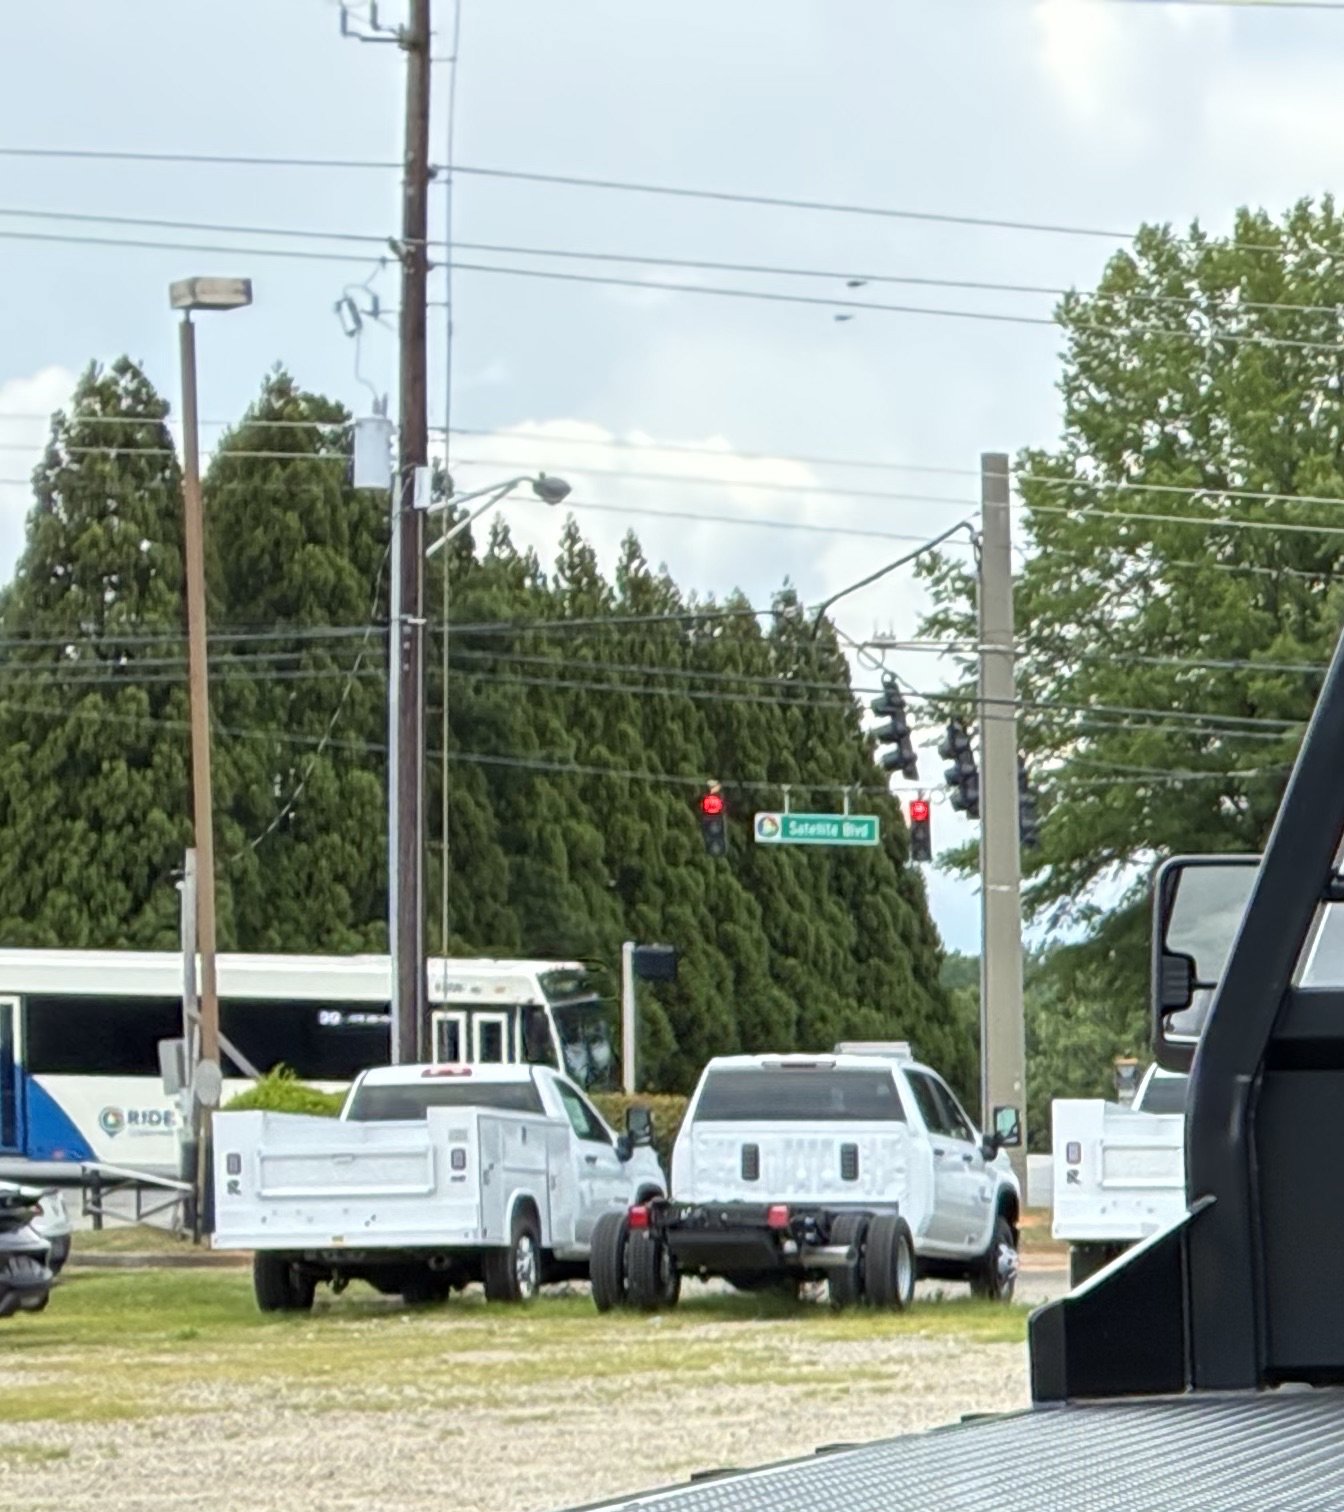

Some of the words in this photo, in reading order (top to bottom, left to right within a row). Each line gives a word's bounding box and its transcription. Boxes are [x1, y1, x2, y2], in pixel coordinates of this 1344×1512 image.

[789, 820, 839, 838] Satellite
[842, 822, 869, 838] Blvd
[127, 1109, 177, 1127] RIDE
